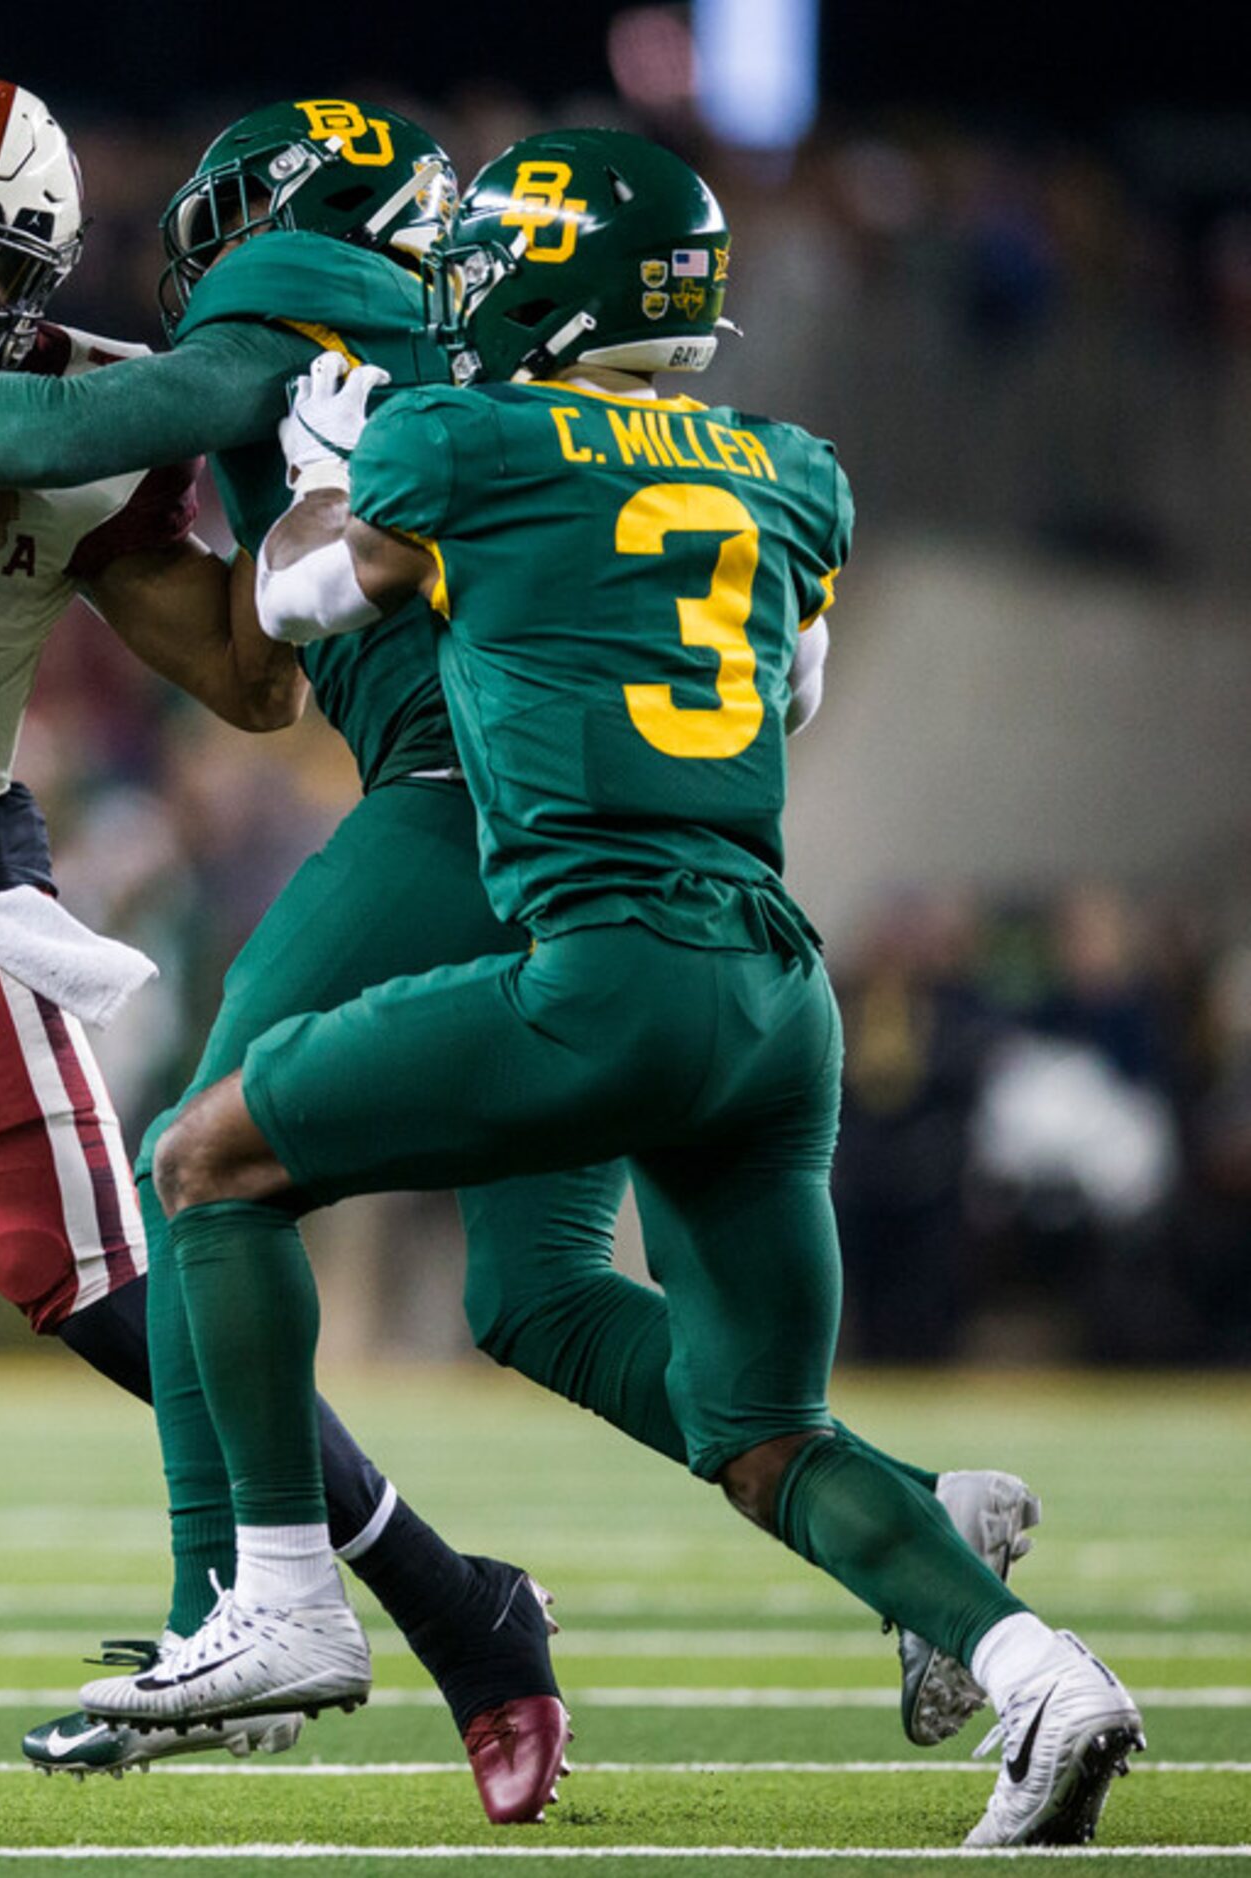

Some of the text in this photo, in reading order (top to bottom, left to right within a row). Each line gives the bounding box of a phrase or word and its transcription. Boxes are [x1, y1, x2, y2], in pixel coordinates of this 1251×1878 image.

[294, 99, 395, 167] BU
[501, 160, 588, 263] BU
[550, 407, 778, 481] C. MILLER
[615, 483, 764, 758] 3
